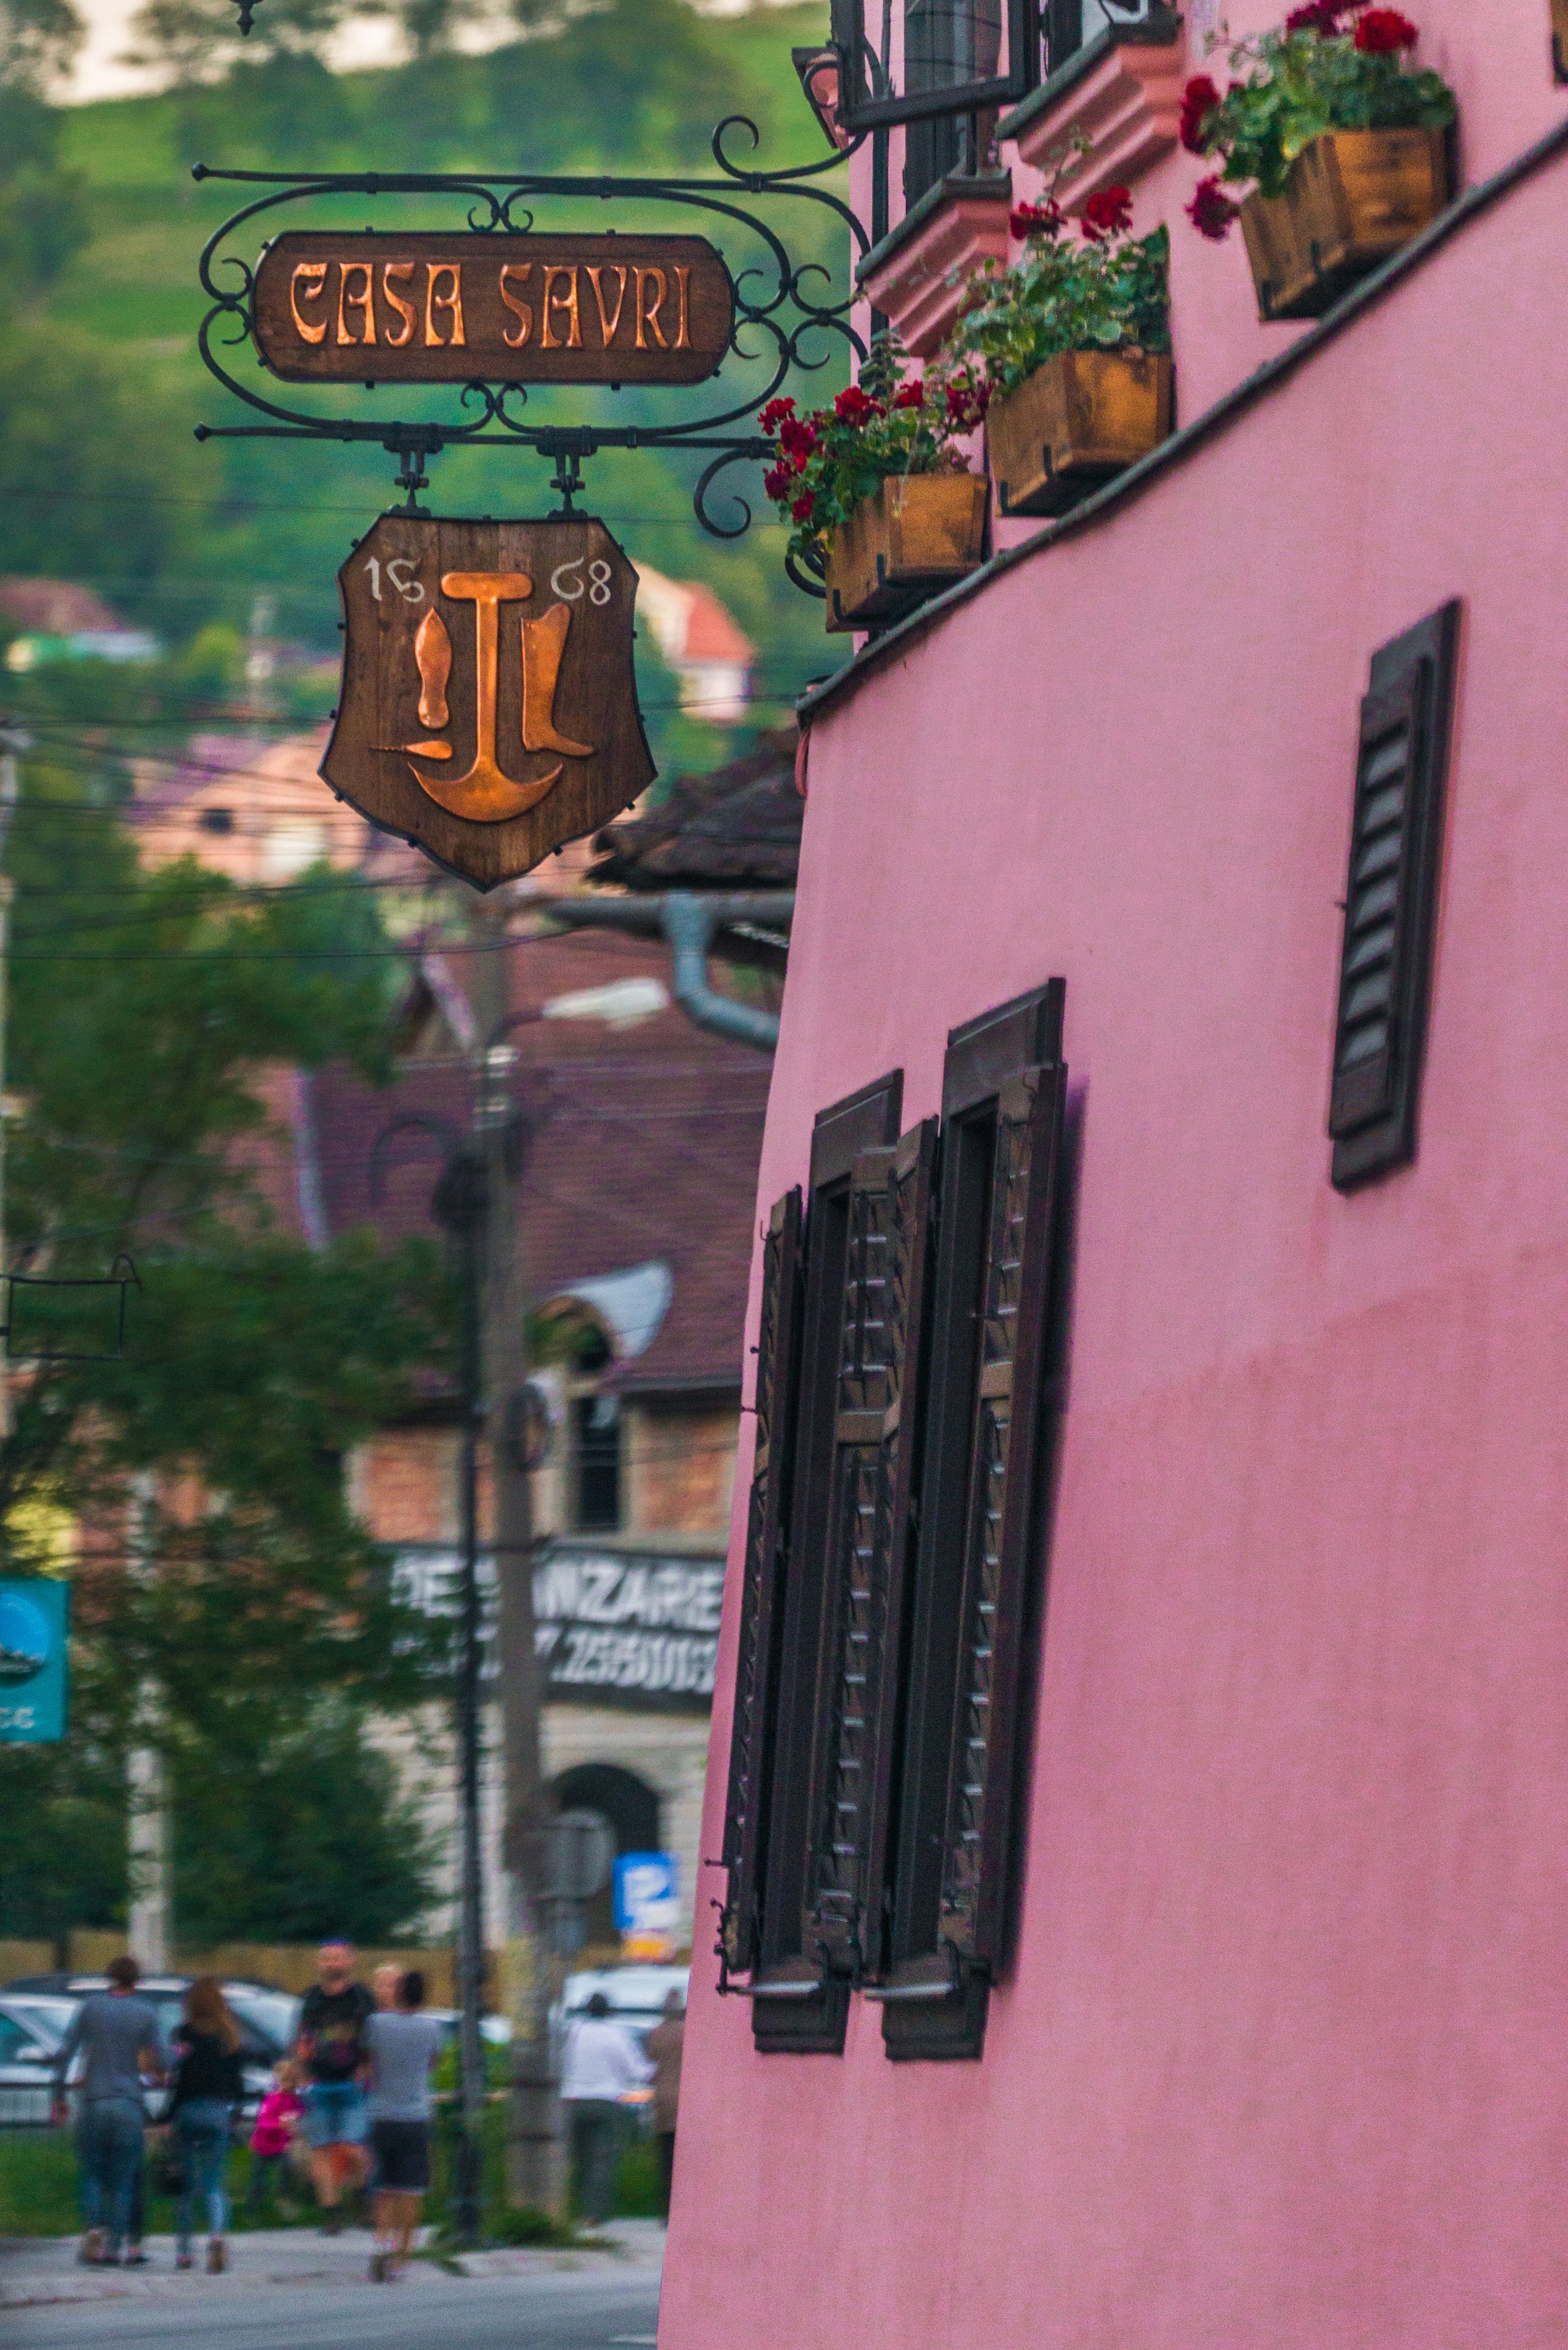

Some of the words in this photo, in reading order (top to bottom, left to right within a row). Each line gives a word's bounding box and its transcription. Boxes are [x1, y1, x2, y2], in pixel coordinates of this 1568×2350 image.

[289, 262, 467, 348] CASA
[499, 262, 693, 349] SAVRI
[551, 555, 612, 606] 68
